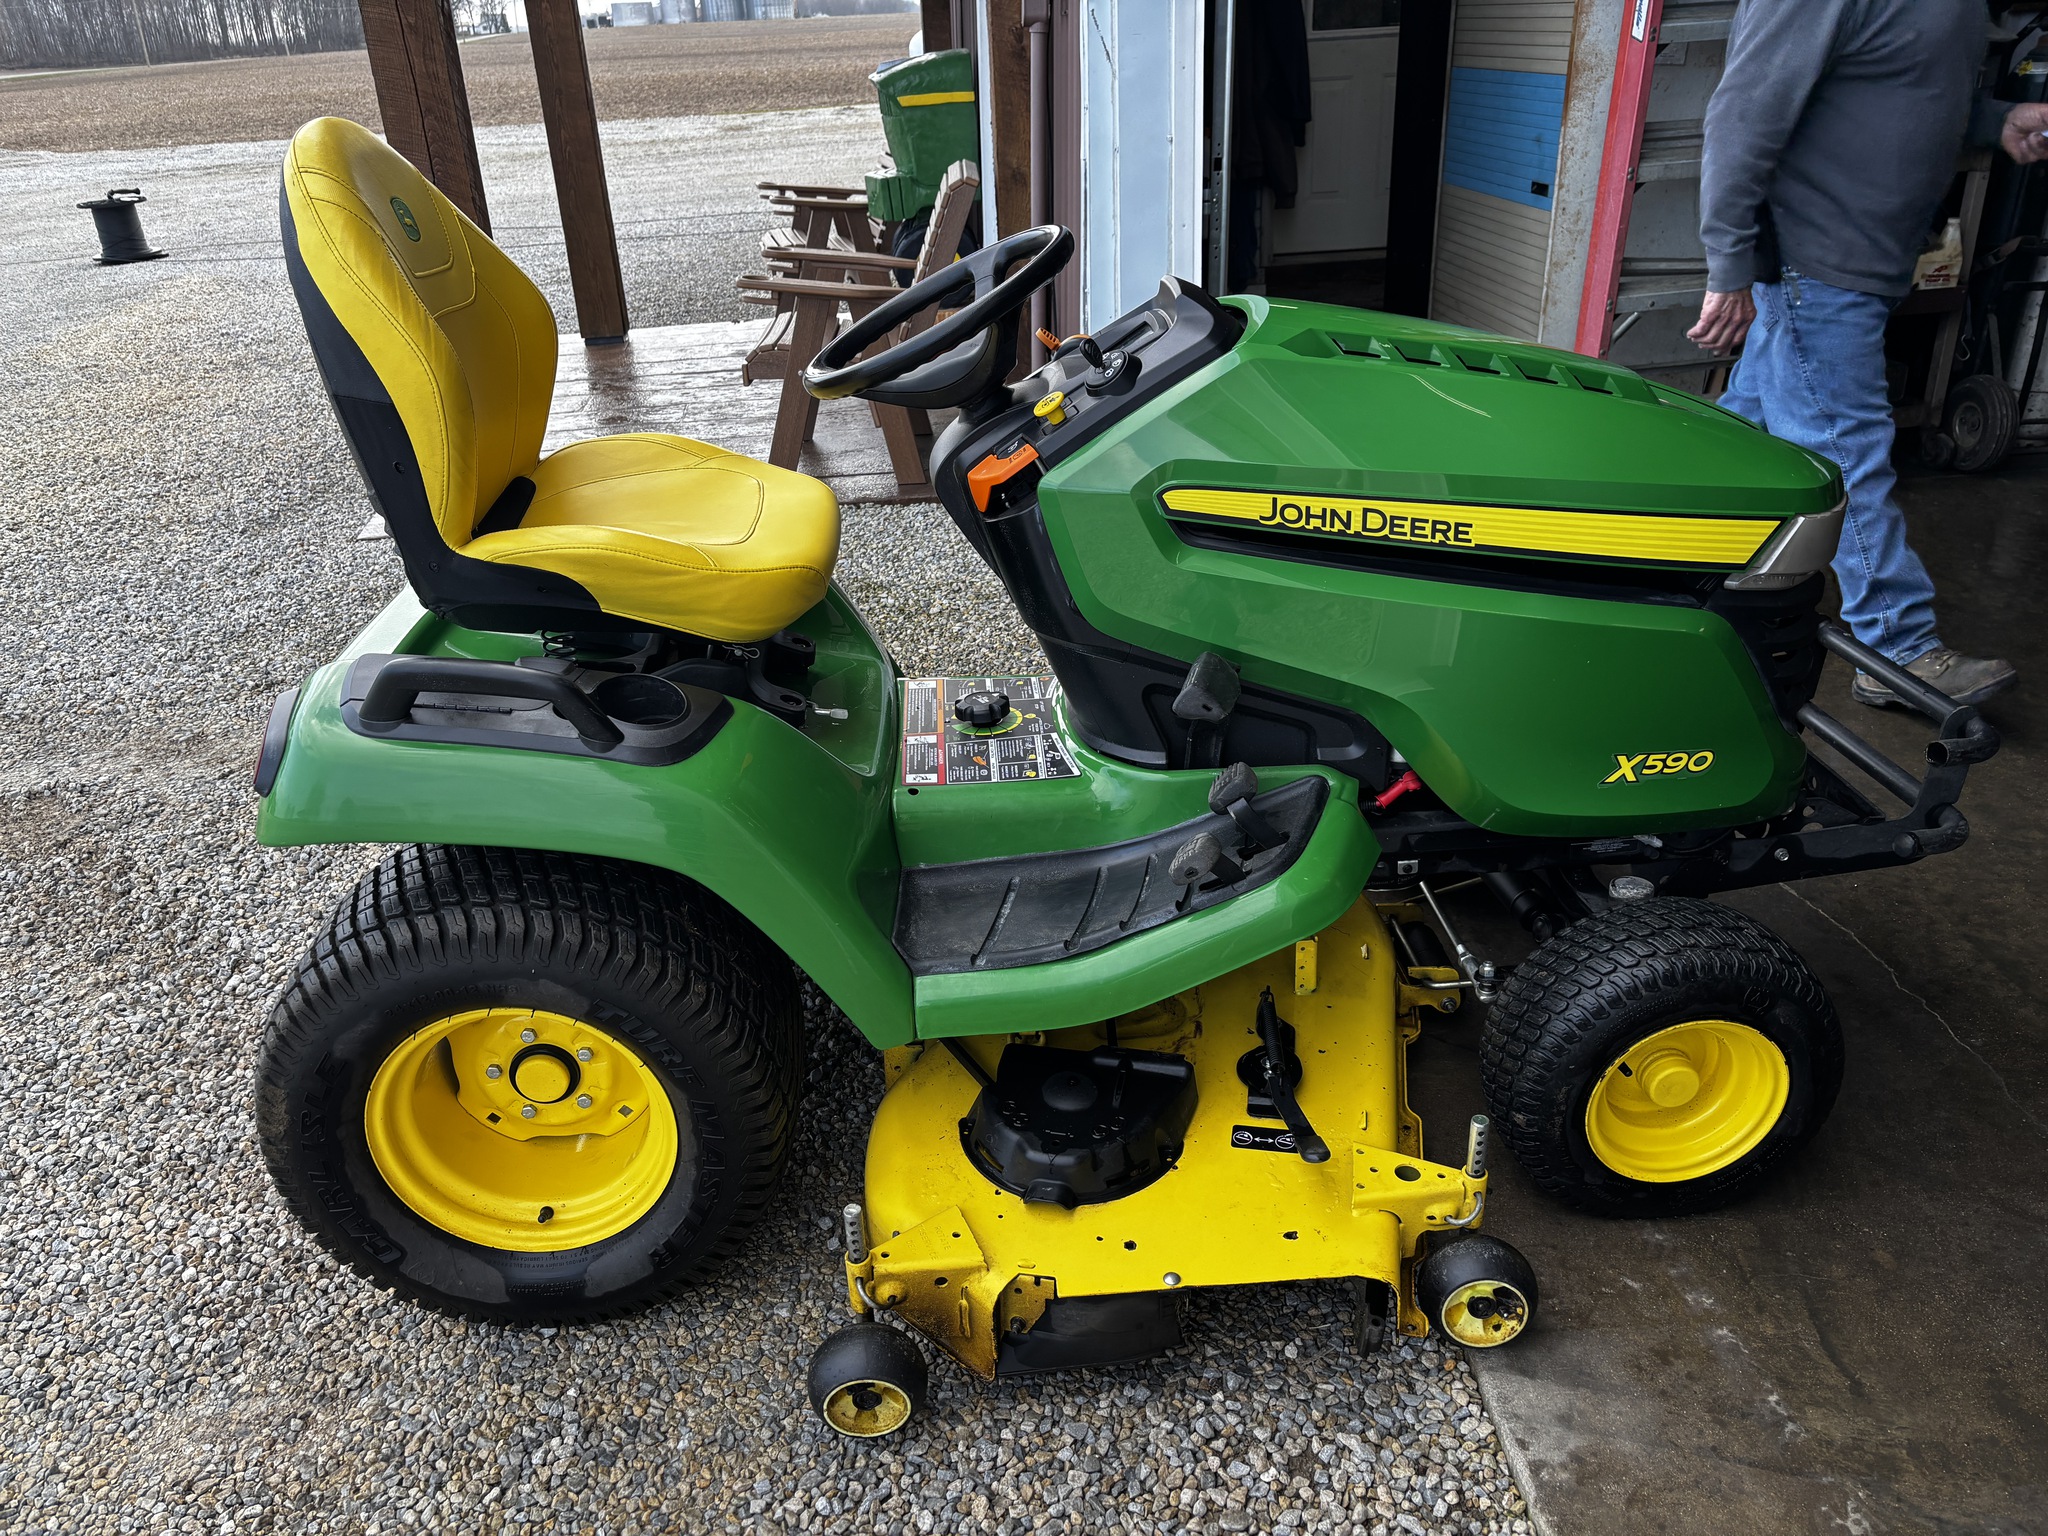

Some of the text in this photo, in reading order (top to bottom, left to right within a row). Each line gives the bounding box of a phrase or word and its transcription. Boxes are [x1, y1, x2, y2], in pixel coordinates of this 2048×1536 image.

[1259, 497, 1473, 543] JOHN DEERE
[1601, 750, 1715, 784] X590
[300, 1050, 404, 1264] CARLISLE
[593, 998, 726, 1269] TURF MASTER
